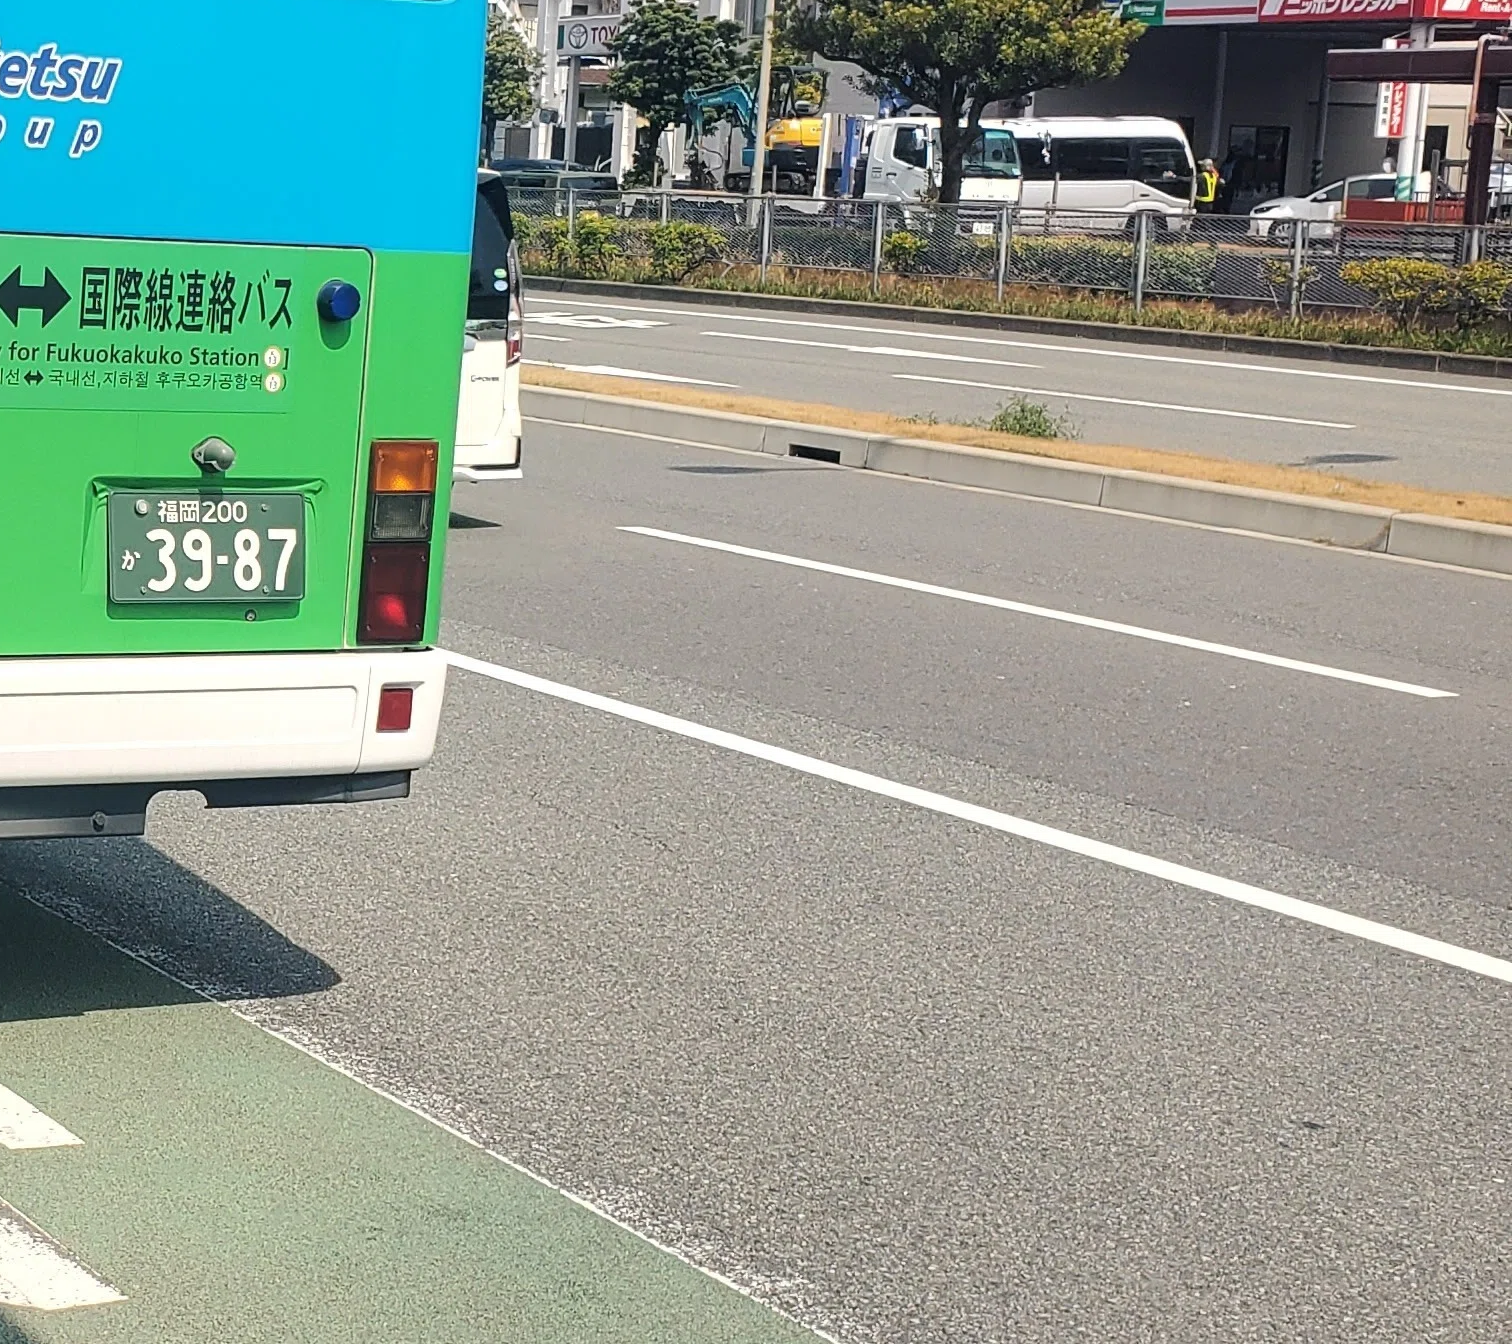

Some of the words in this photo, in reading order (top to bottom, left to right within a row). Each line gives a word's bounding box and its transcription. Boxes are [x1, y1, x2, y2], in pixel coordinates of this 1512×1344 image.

[590, 26, 620, 45] TOY
[79, 266, 294, 335] 国際線連絡バス
[8, 341, 41, 362] for
[45, 343, 183, 366] Fukuokakuko
[189, 347, 260, 368] Station
[155, 371, 264, 391] 후쿠오카공항역
[121, 549, 141, 571] か
[145, 528, 297, 593] 39-87
